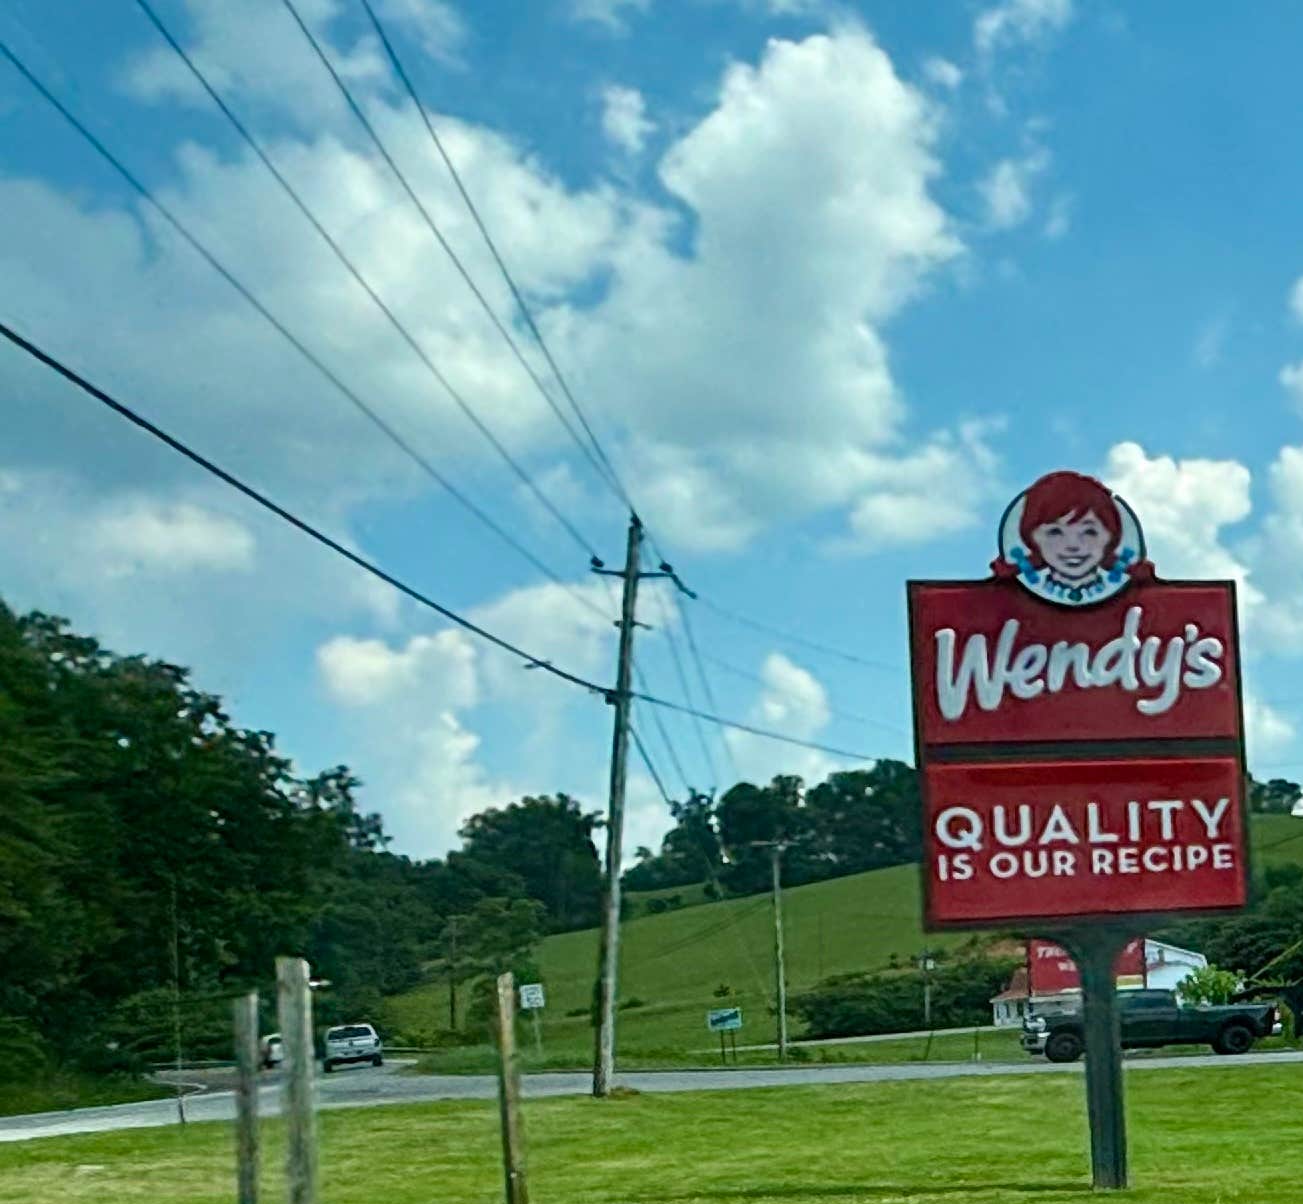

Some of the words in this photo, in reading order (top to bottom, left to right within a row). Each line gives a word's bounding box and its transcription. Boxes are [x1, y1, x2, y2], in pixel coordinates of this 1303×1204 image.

[934, 606, 1224, 721] Wendy's
[935, 798, 1230, 851] QUALITY
[938, 852, 973, 881] IS
[989, 849, 1077, 880] OUR
[1092, 842, 1233, 874] RECIPE
